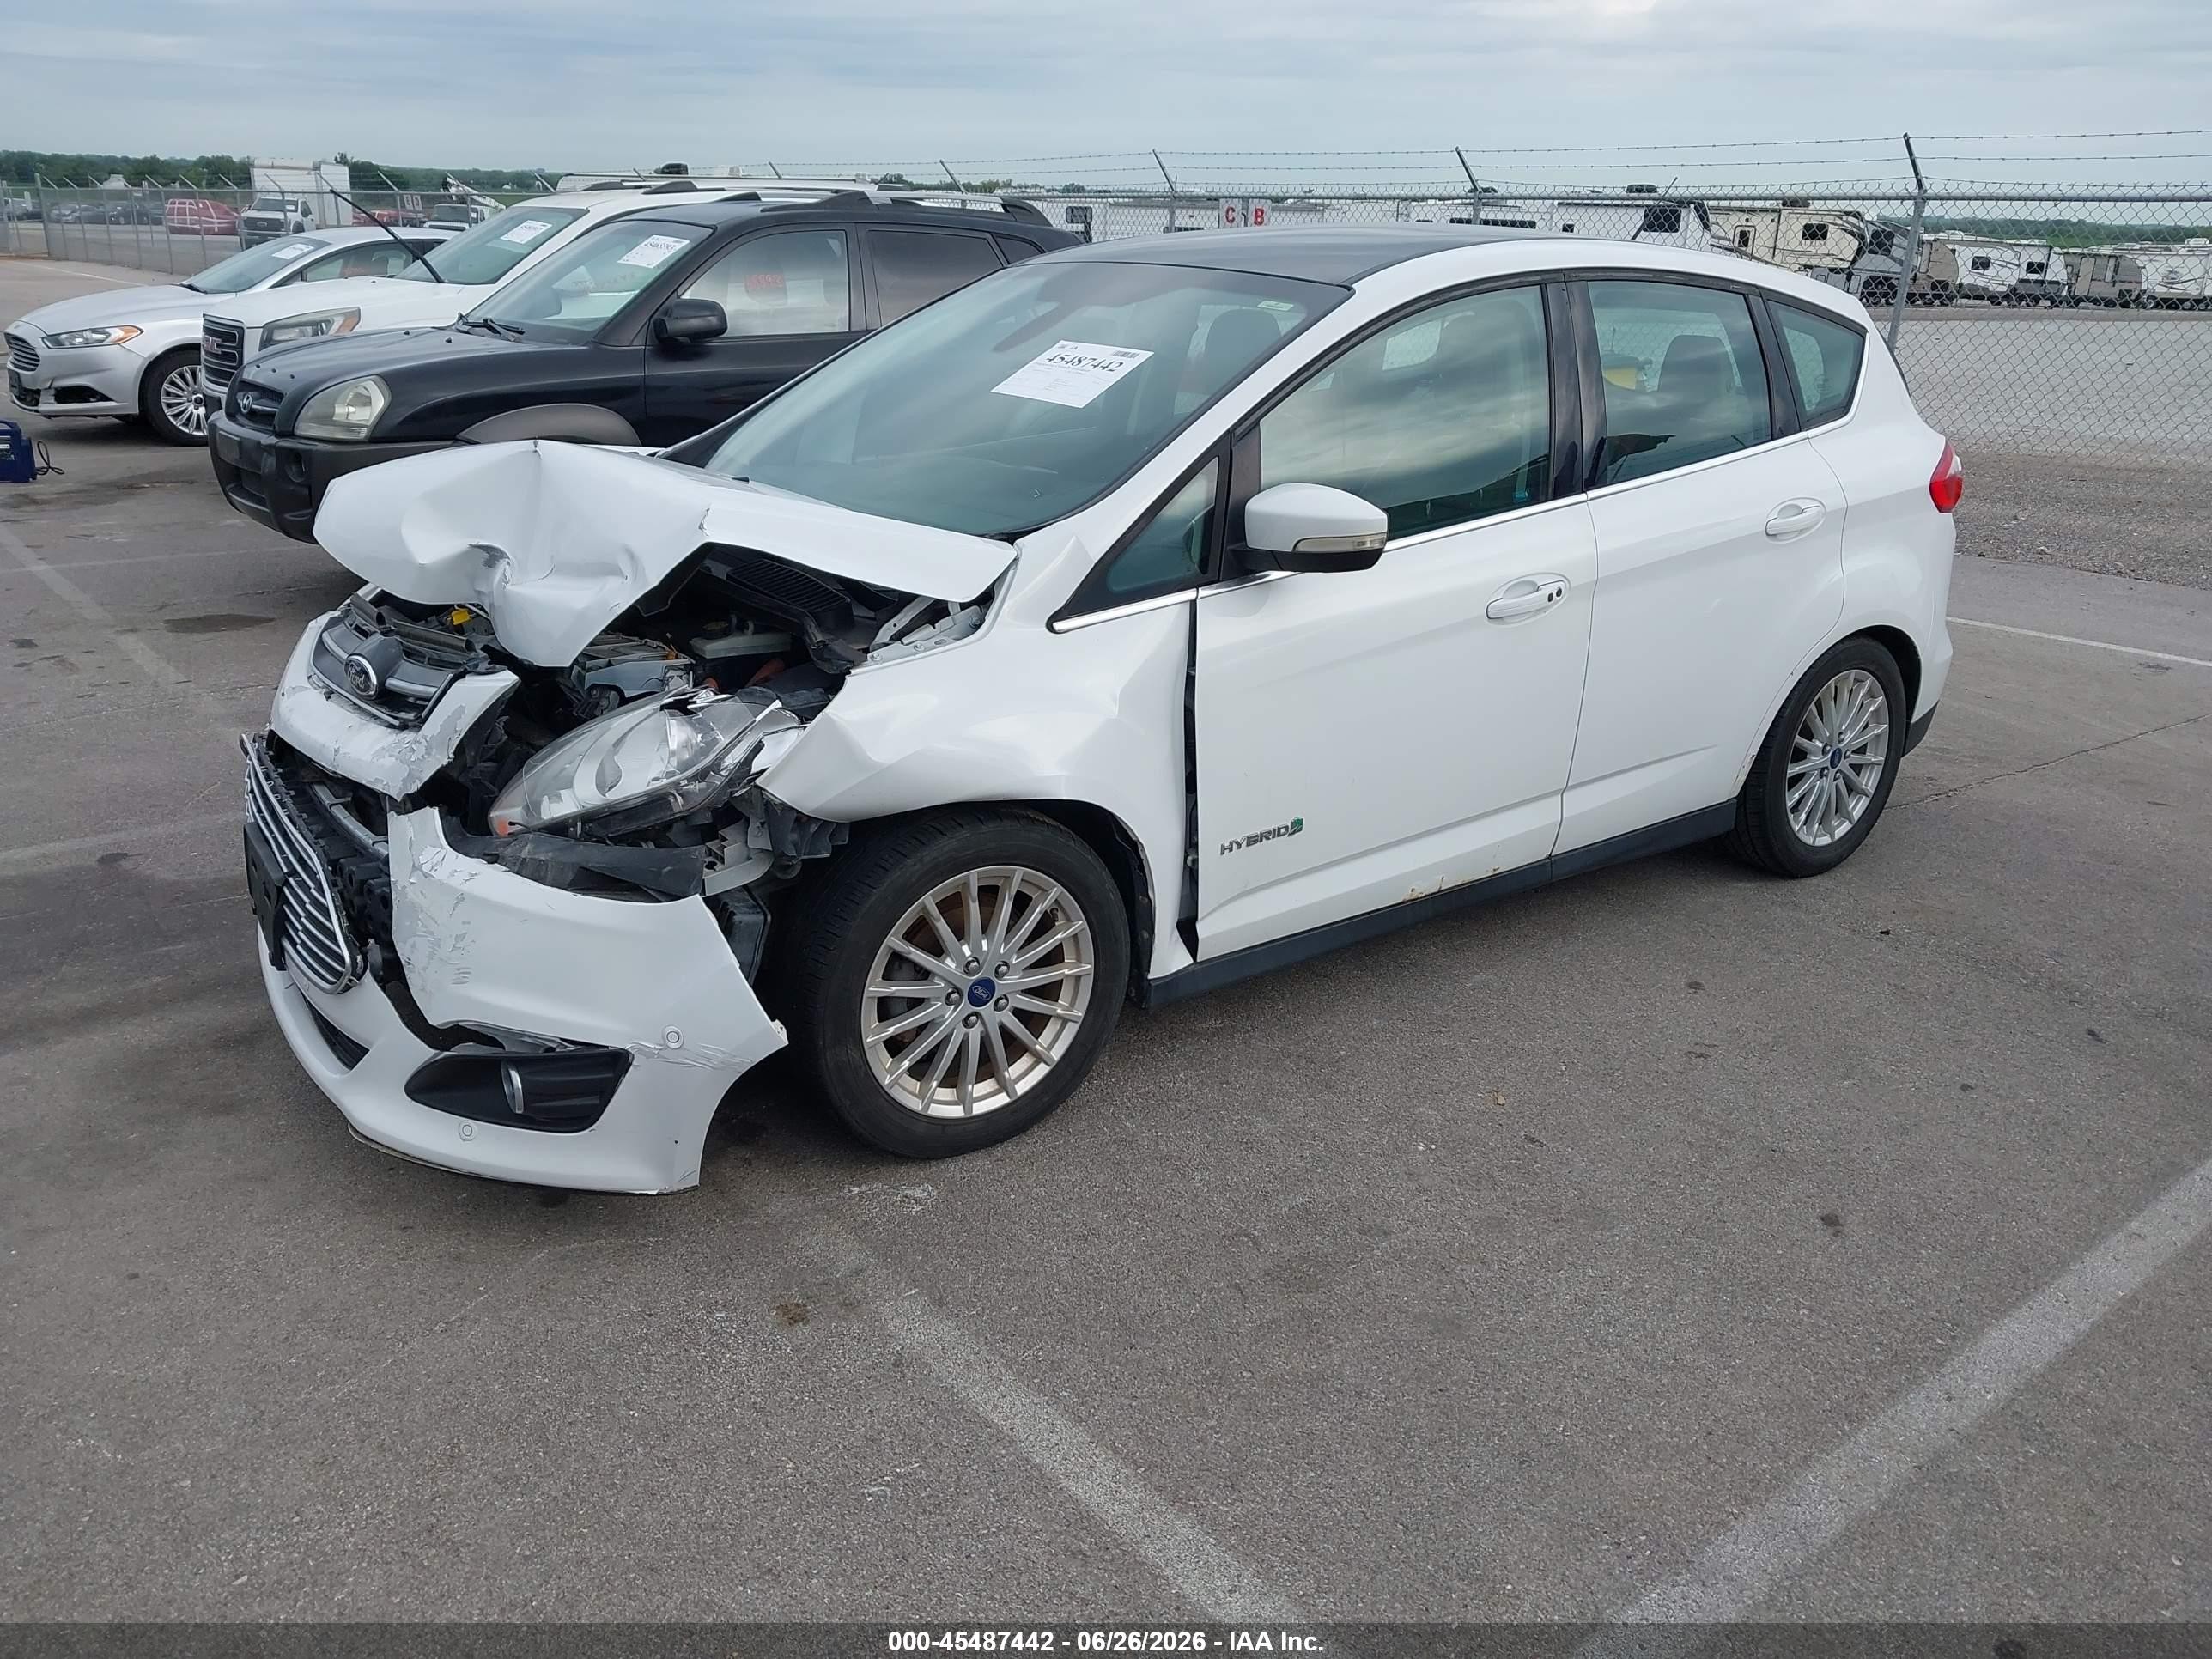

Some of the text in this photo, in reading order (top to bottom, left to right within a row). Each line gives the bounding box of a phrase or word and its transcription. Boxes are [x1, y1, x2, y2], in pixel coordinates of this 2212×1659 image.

[1225, 206, 1236, 223] C
[1254, 208, 1264, 225] B
[1046, 352, 1124, 372] 45487442
[1220, 824, 1290, 856] HYBRID
